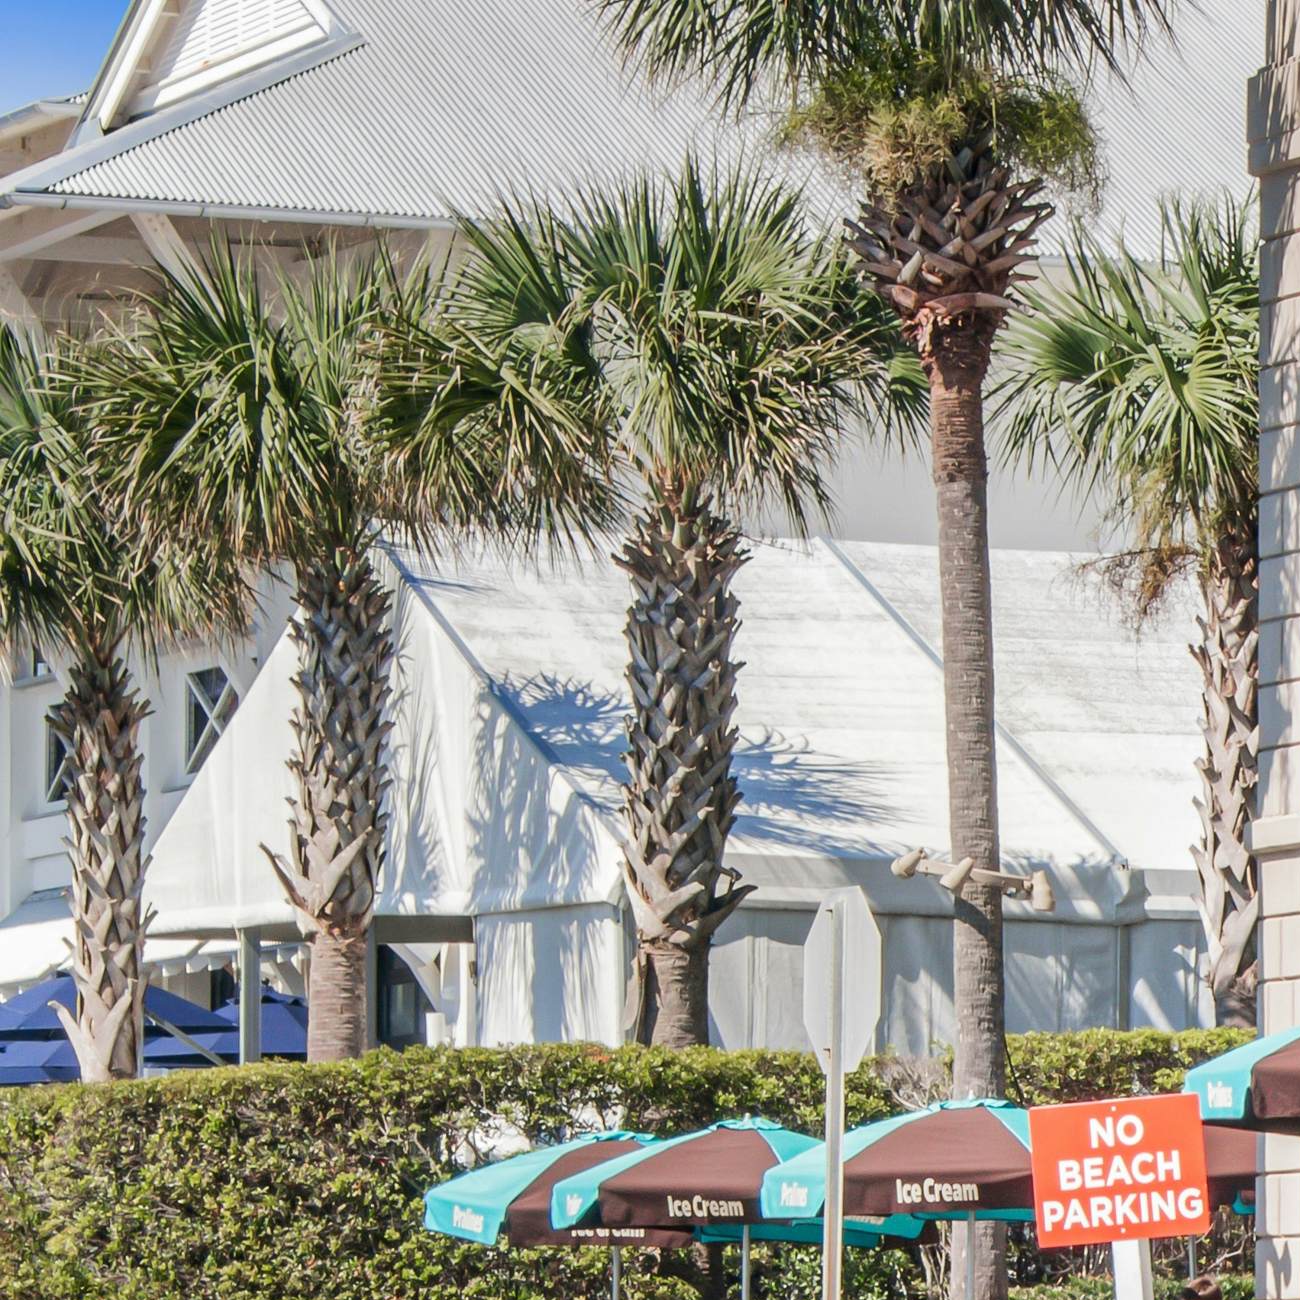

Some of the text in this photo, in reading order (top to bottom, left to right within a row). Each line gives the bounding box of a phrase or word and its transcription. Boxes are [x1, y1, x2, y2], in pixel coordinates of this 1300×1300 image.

[1089, 1114, 1144, 1149] NO
[1058, 1150, 1181, 1191] BEACH
[667, 1195, 744, 1217] Ice Cream
[896, 1177, 979, 1204] Ice Cream
[1043, 1188, 1204, 1232] PARKING
